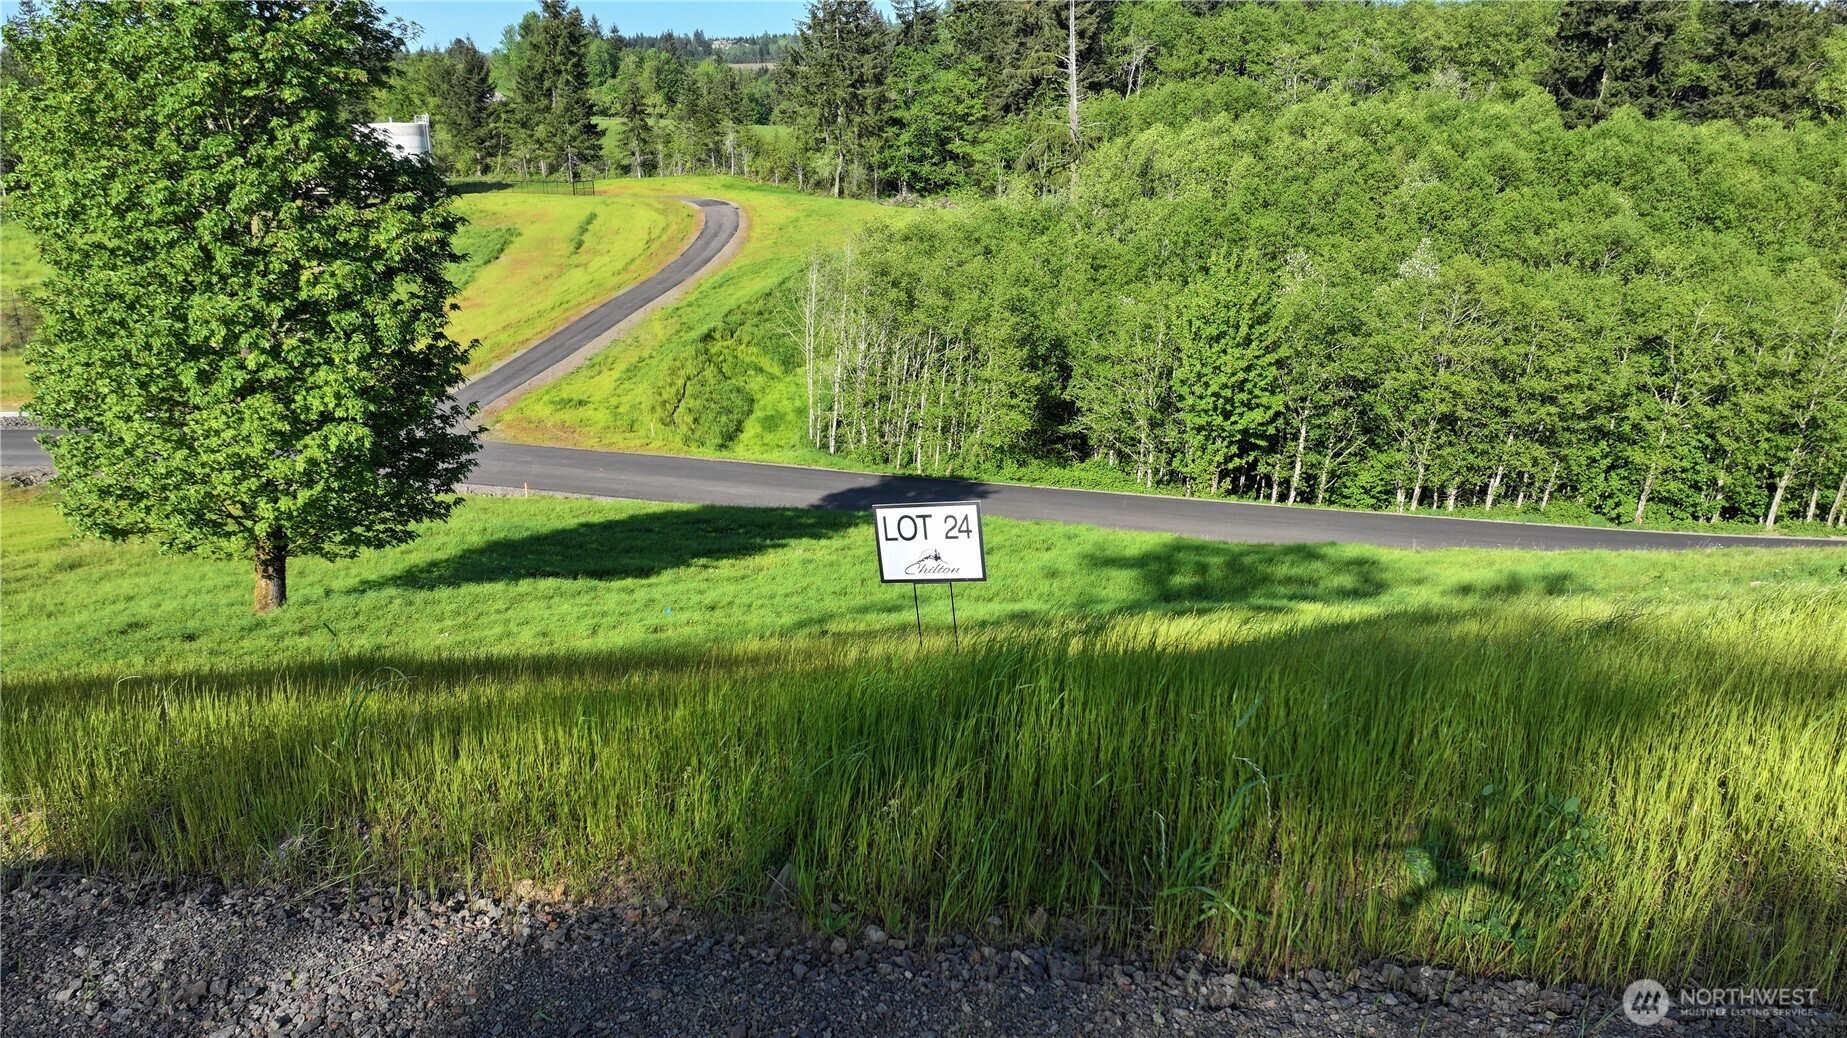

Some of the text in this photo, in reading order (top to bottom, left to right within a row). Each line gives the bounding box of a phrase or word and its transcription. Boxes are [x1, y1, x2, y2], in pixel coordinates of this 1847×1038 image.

[883, 514, 972, 541] LOT 24
[904, 562, 960, 575] Chilton
